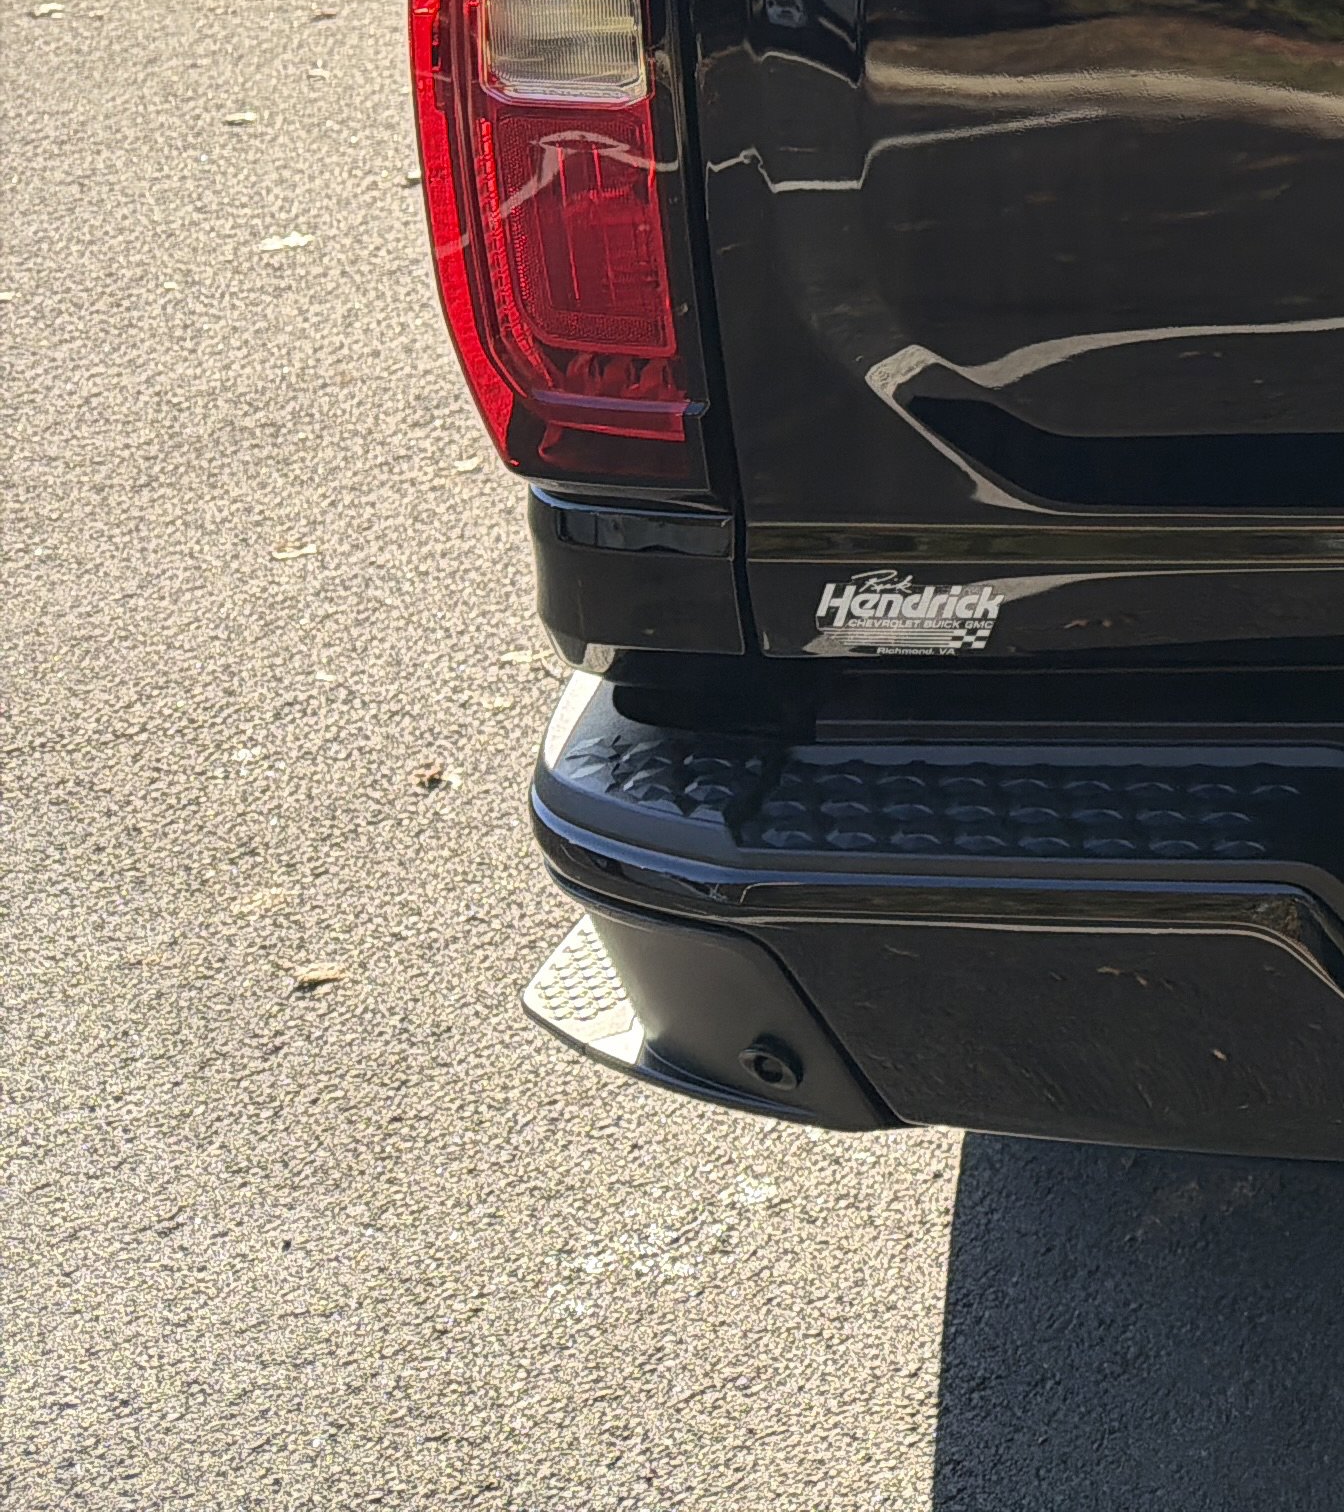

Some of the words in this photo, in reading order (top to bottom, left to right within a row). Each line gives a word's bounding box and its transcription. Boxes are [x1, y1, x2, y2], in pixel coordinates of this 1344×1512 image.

[816, 583, 1004, 627] Hendrick
[847, 619, 921, 629] CHEVROLET
[923, 620, 961, 629] BUICK
[964, 620, 994, 629] GMC
[938, 648, 956, 656] VA
